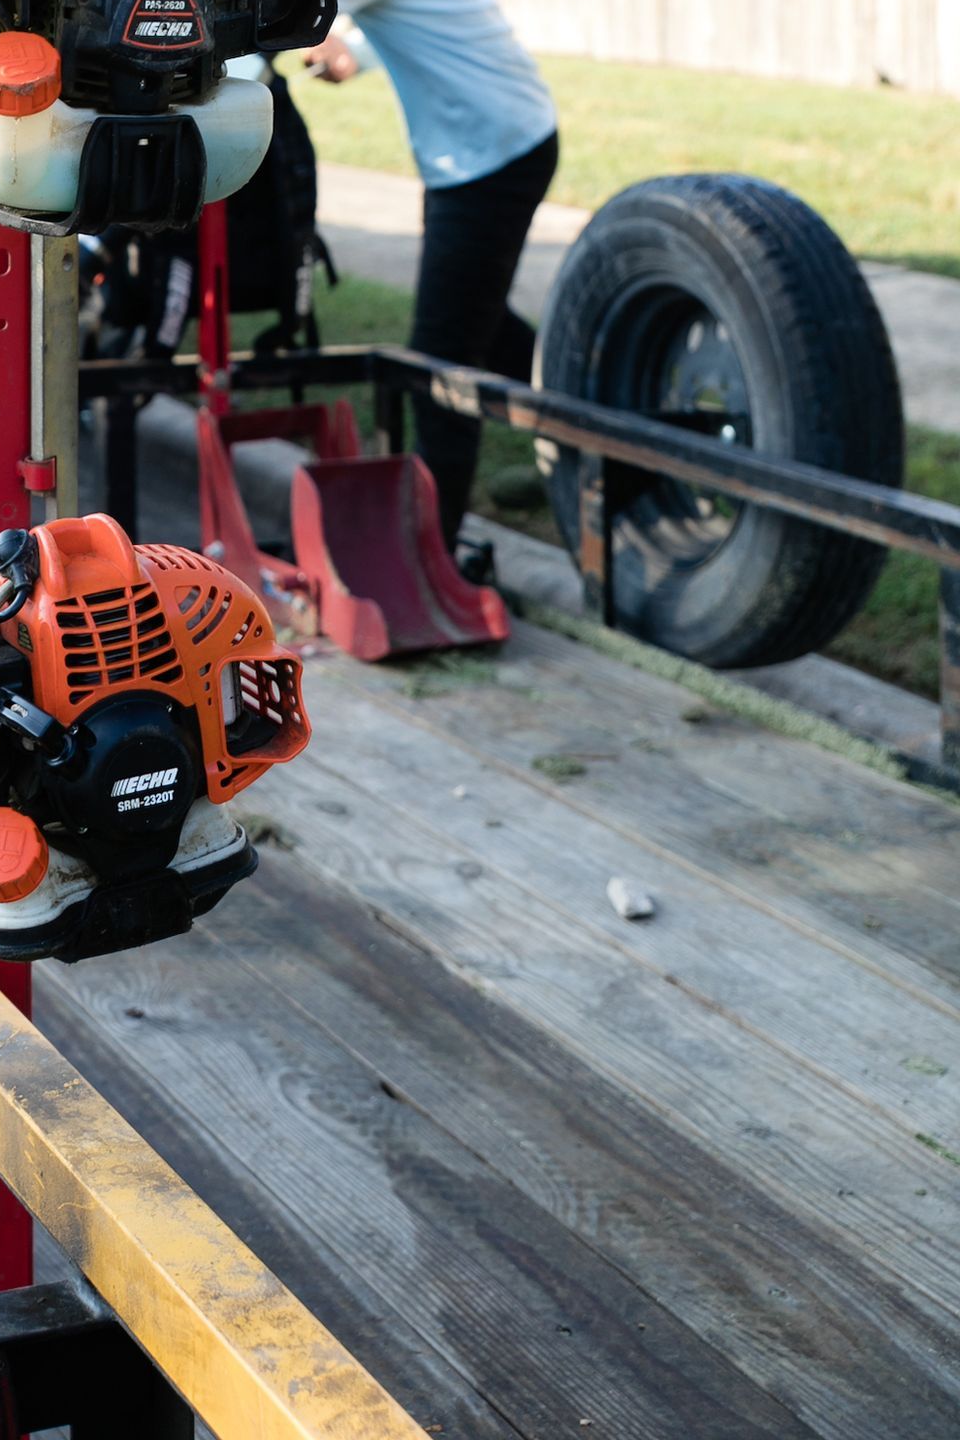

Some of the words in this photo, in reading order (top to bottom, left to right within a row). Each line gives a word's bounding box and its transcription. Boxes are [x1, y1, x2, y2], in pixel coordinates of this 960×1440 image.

[144, 0, 186, 10] PAS-2620
[146, 21, 193, 37] ECHO
[124, 767, 178, 794] ECHO
[117, 790, 175, 813] SRM-2320T
